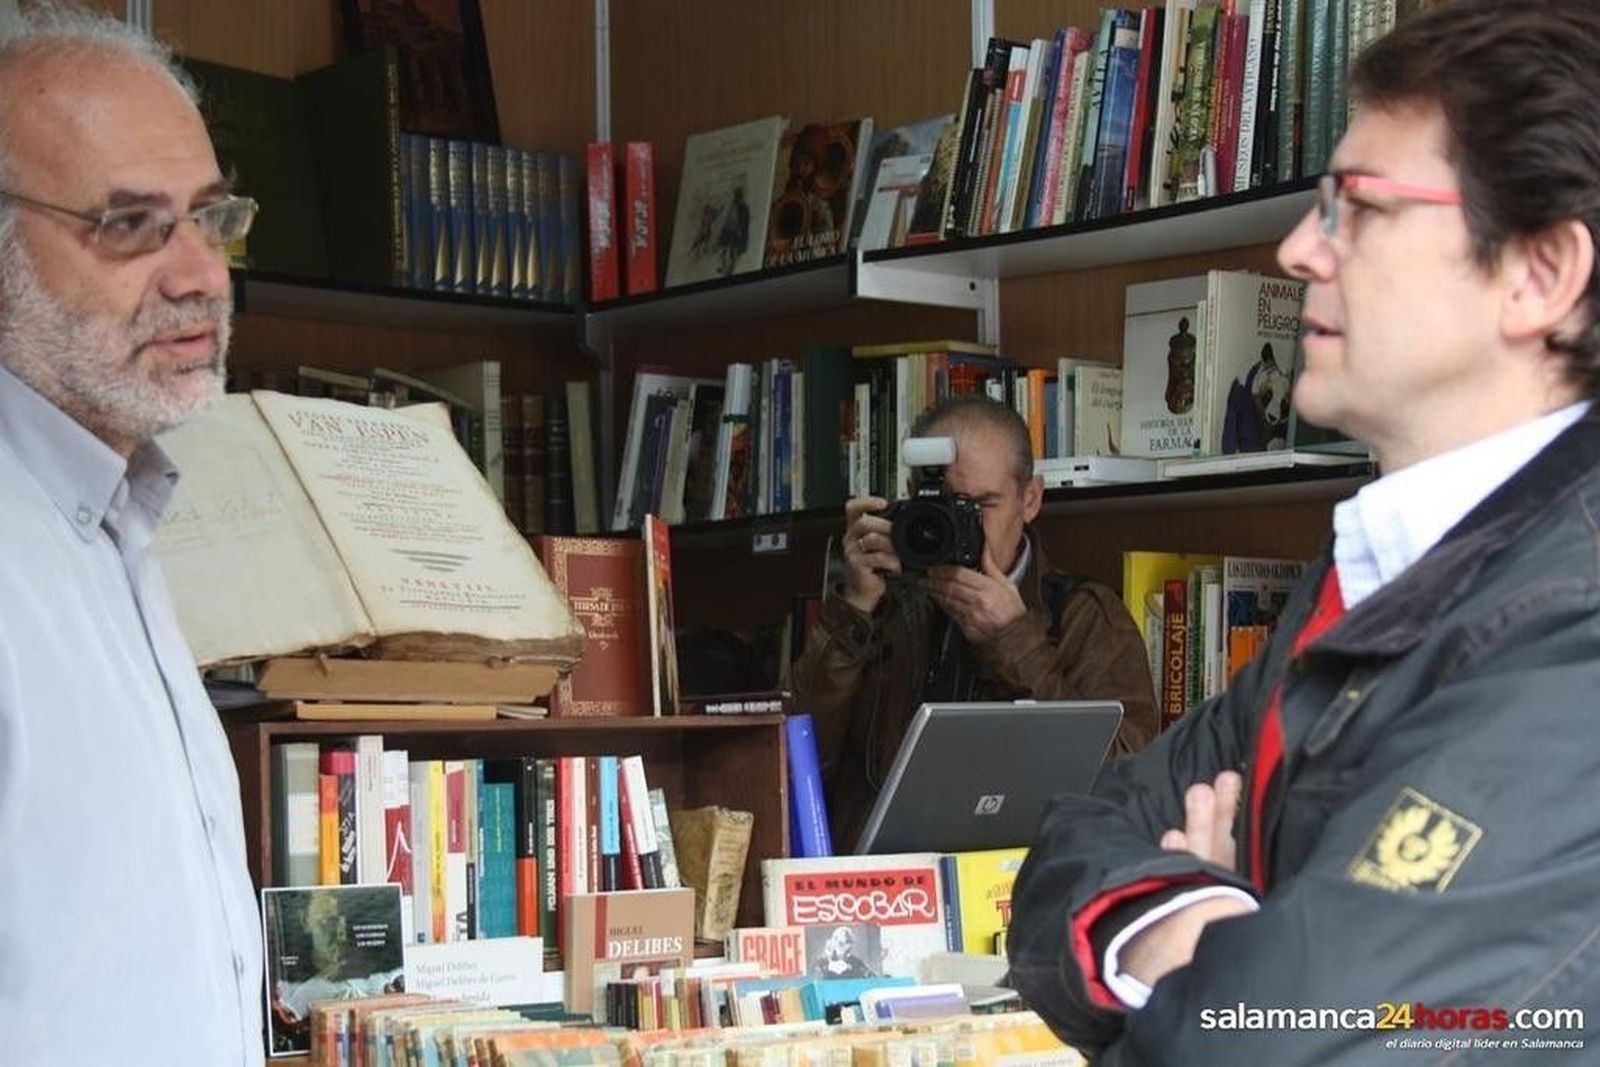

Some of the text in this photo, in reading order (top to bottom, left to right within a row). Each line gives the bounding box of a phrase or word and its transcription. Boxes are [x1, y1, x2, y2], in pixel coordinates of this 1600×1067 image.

[1243, 38, 1257, 110] VATICANO
[1259, 282, 1304, 301] ANIMALE
[1258, 298, 1271, 312] EN
[1257, 313, 1301, 331] PELIGRO
[1169, 613, 1187, 715] BRICOLAJE
[794, 875, 926, 891] EL MUNDO DE
[792, 889, 936, 923] ESCOBAR
[609, 925, 644, 937] MIGUEL
[608, 936, 683, 958] DELIBES
